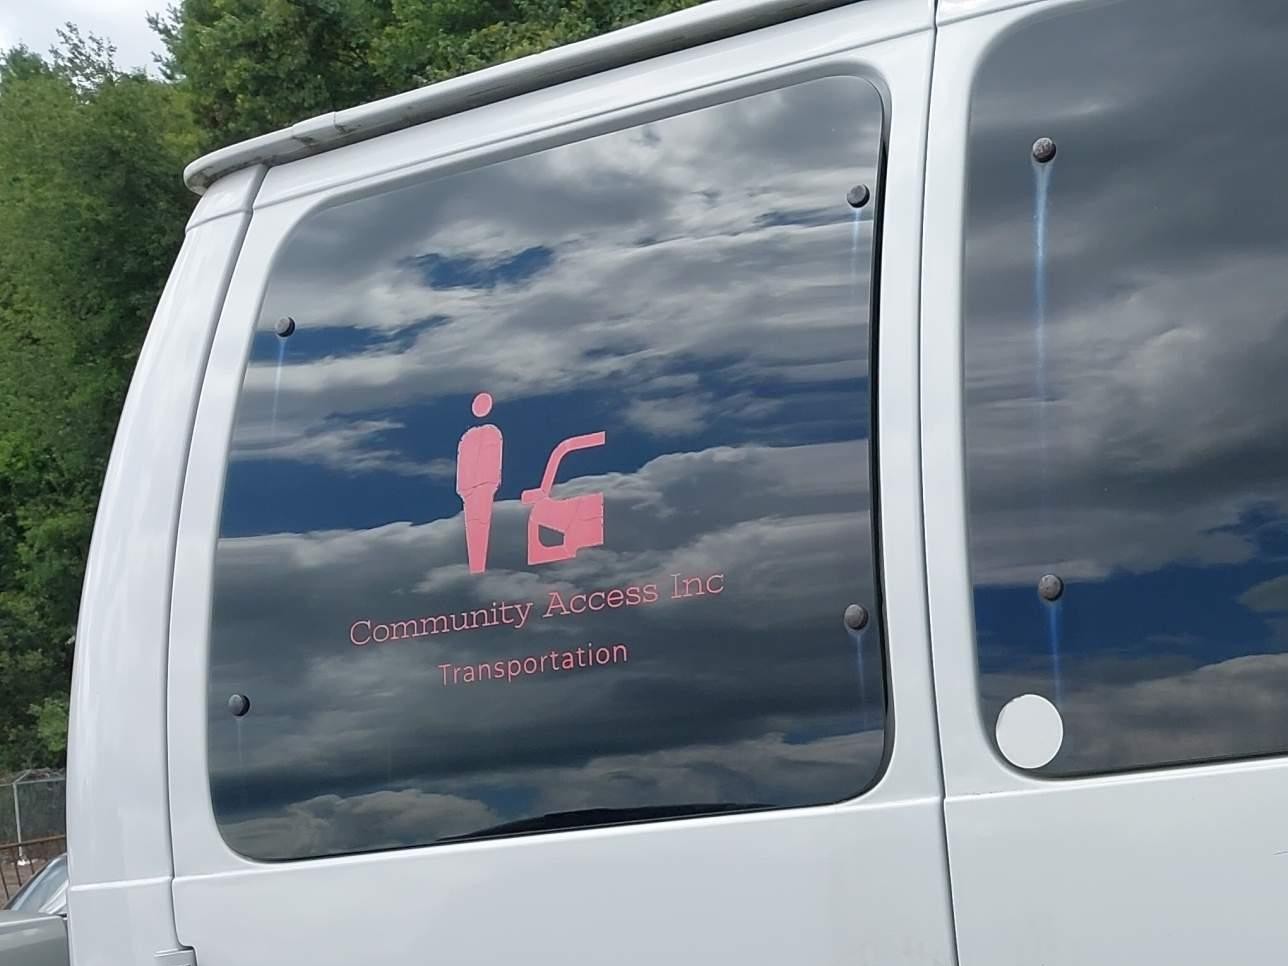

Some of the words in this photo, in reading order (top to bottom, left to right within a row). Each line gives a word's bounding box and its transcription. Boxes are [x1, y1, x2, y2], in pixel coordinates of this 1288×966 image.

[349, 598, 534, 646] Community
[542, 580, 659, 619] Access
[669, 571, 726, 601] Inc
[437, 642, 630, 687] Transportation
